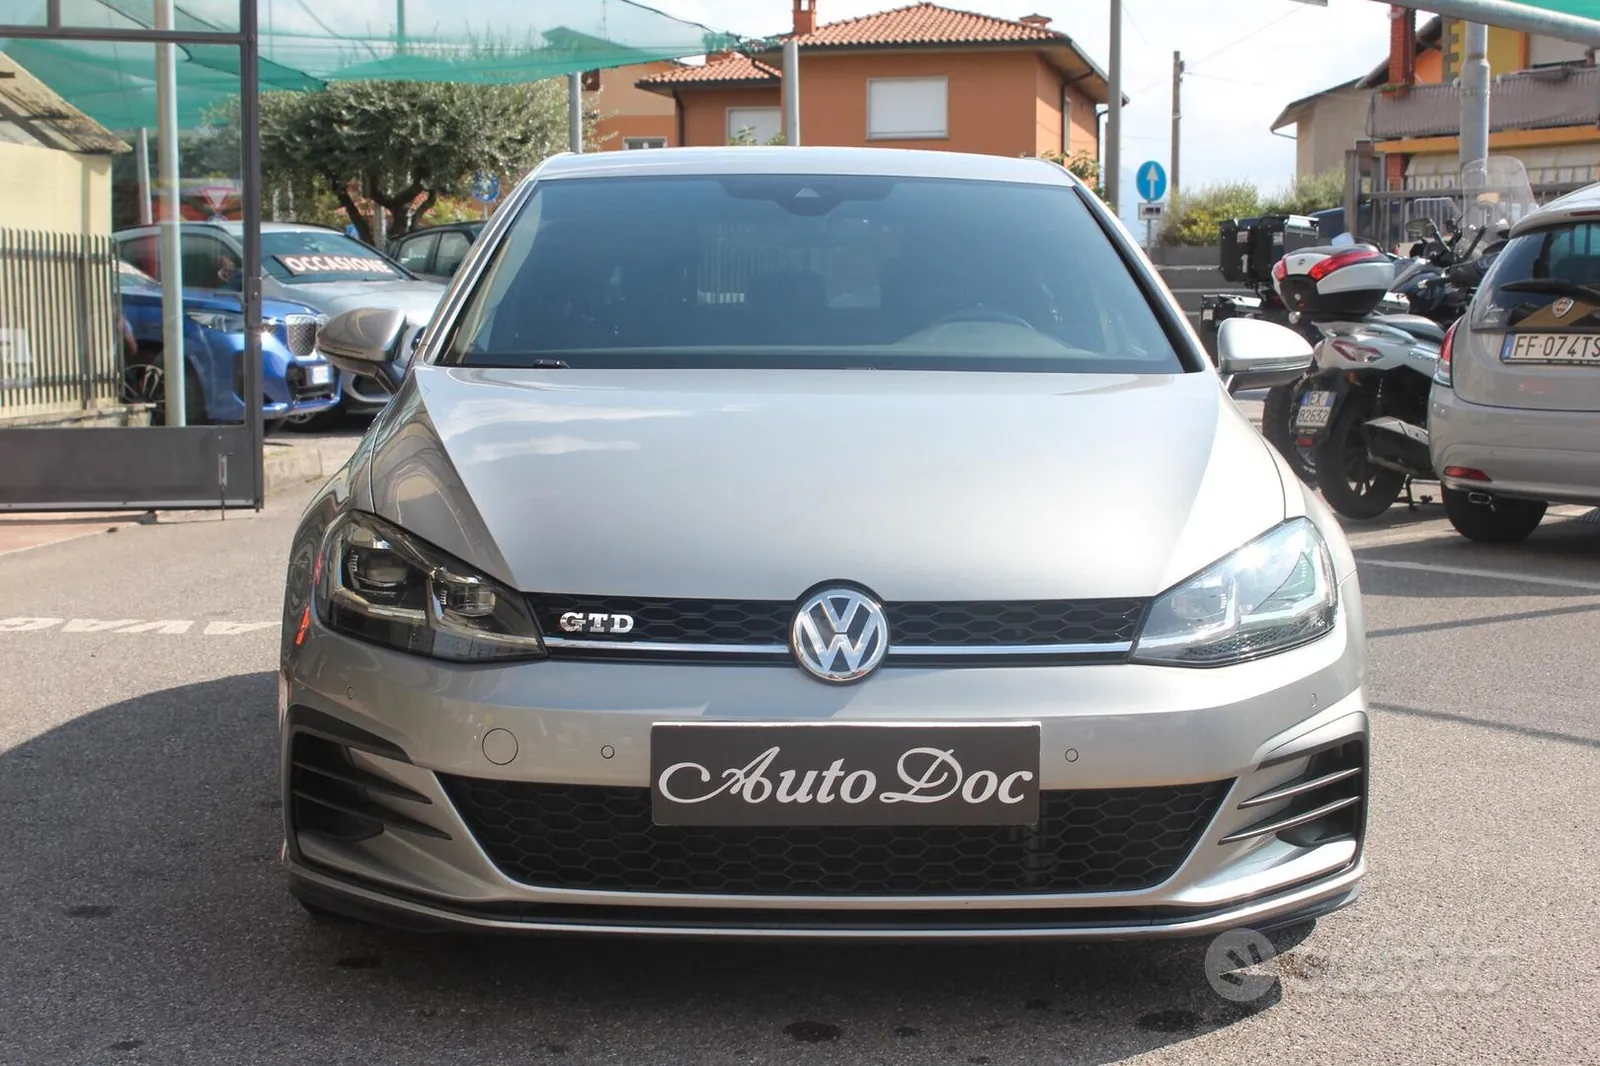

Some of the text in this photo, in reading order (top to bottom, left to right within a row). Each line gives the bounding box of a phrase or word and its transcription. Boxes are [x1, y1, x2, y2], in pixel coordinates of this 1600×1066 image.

[284, 256, 395, 274] OCCASIONE
[560, 612, 634, 633] GTD
[658, 745, 1033, 804] Auto Doc
